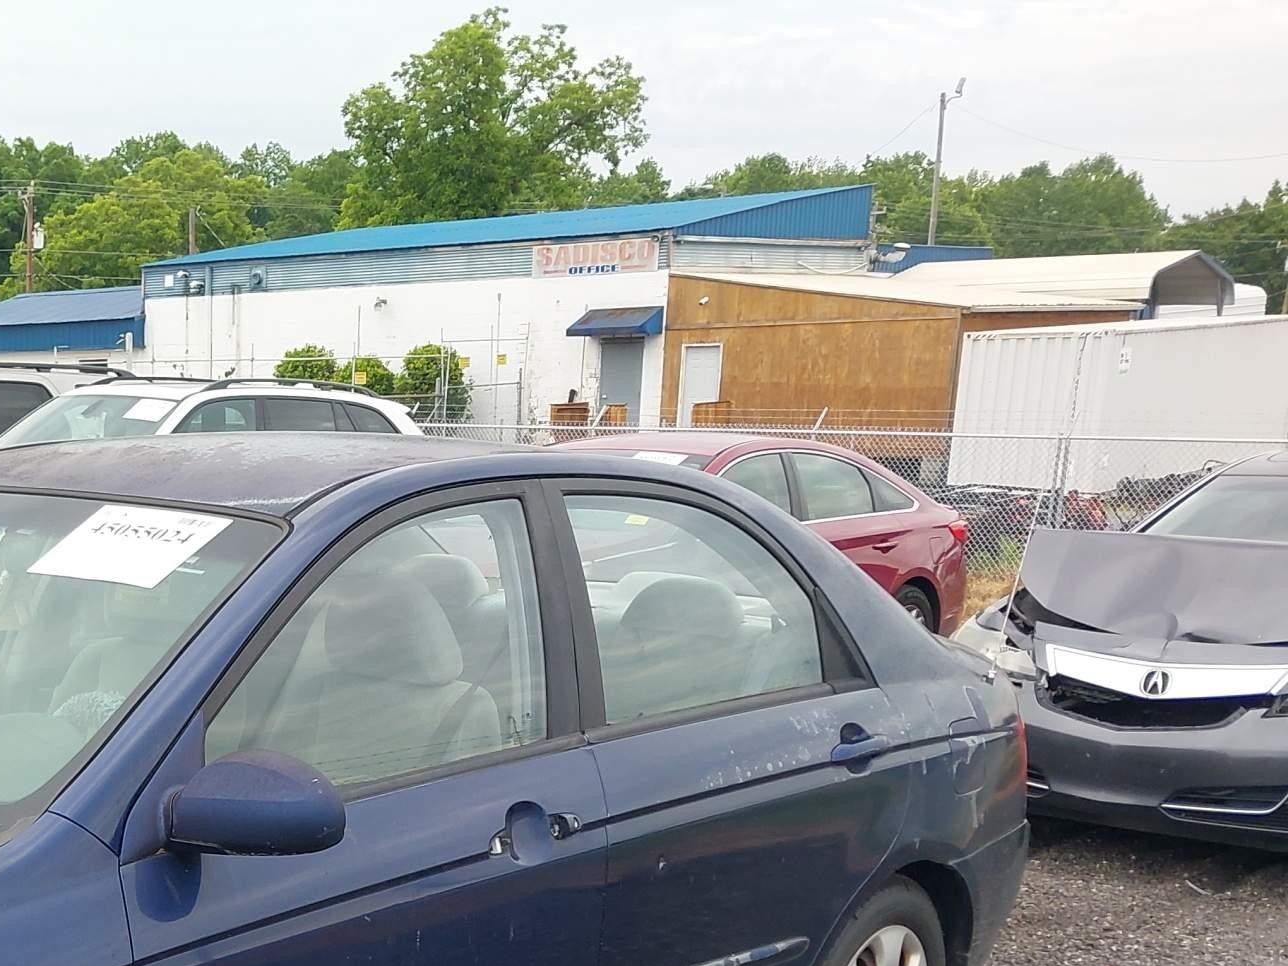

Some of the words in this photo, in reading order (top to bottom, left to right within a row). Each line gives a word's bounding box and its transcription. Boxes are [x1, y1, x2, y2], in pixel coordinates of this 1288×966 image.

[537, 240, 655, 266] SADISCO
[568, 264, 620, 275] OFFICE
[91, 522, 196, 545] 45055024
